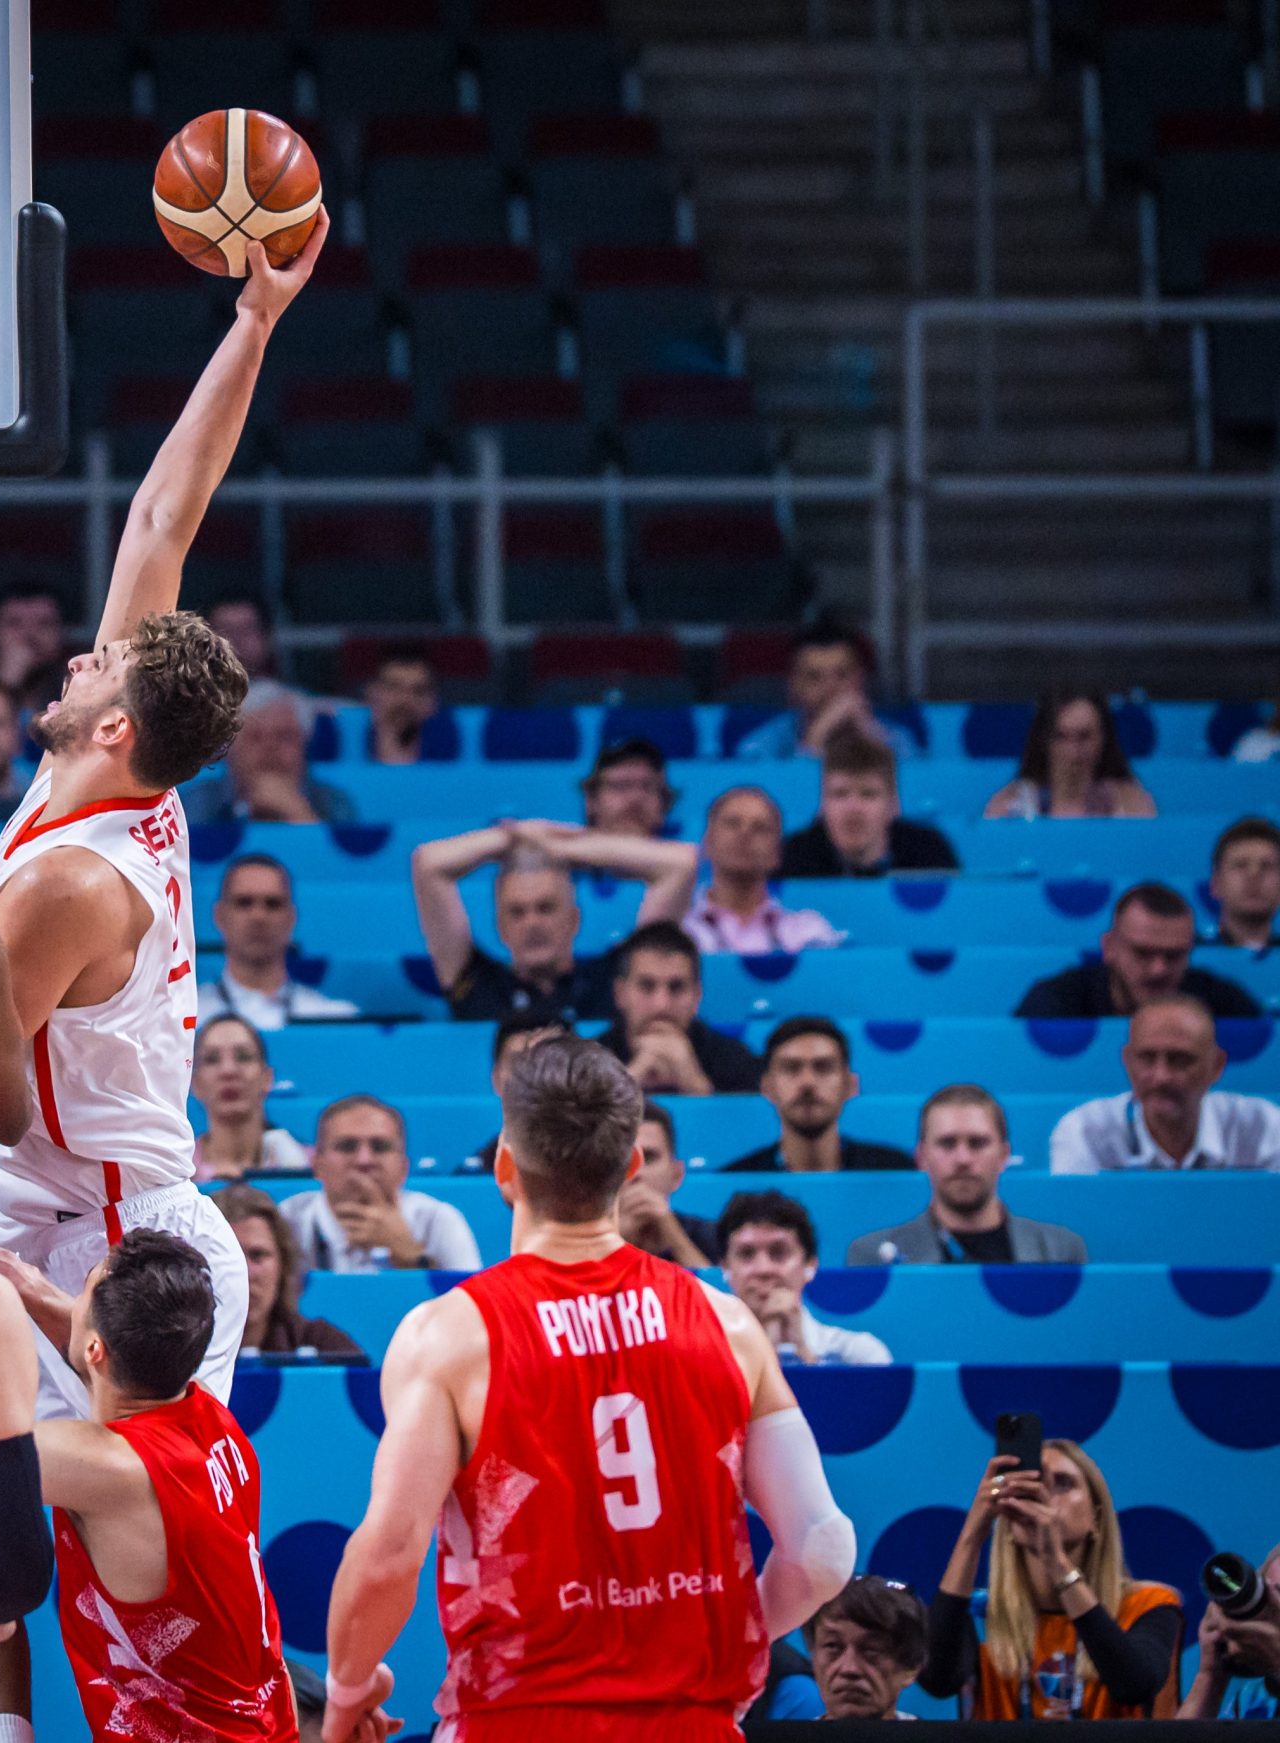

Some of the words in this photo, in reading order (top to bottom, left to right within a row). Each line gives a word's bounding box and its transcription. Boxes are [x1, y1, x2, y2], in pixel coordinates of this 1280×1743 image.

[536, 1286, 667, 1357] PONTKA
[592, 1392, 662, 1532] 9
[607, 1576, 663, 1607] Bank
